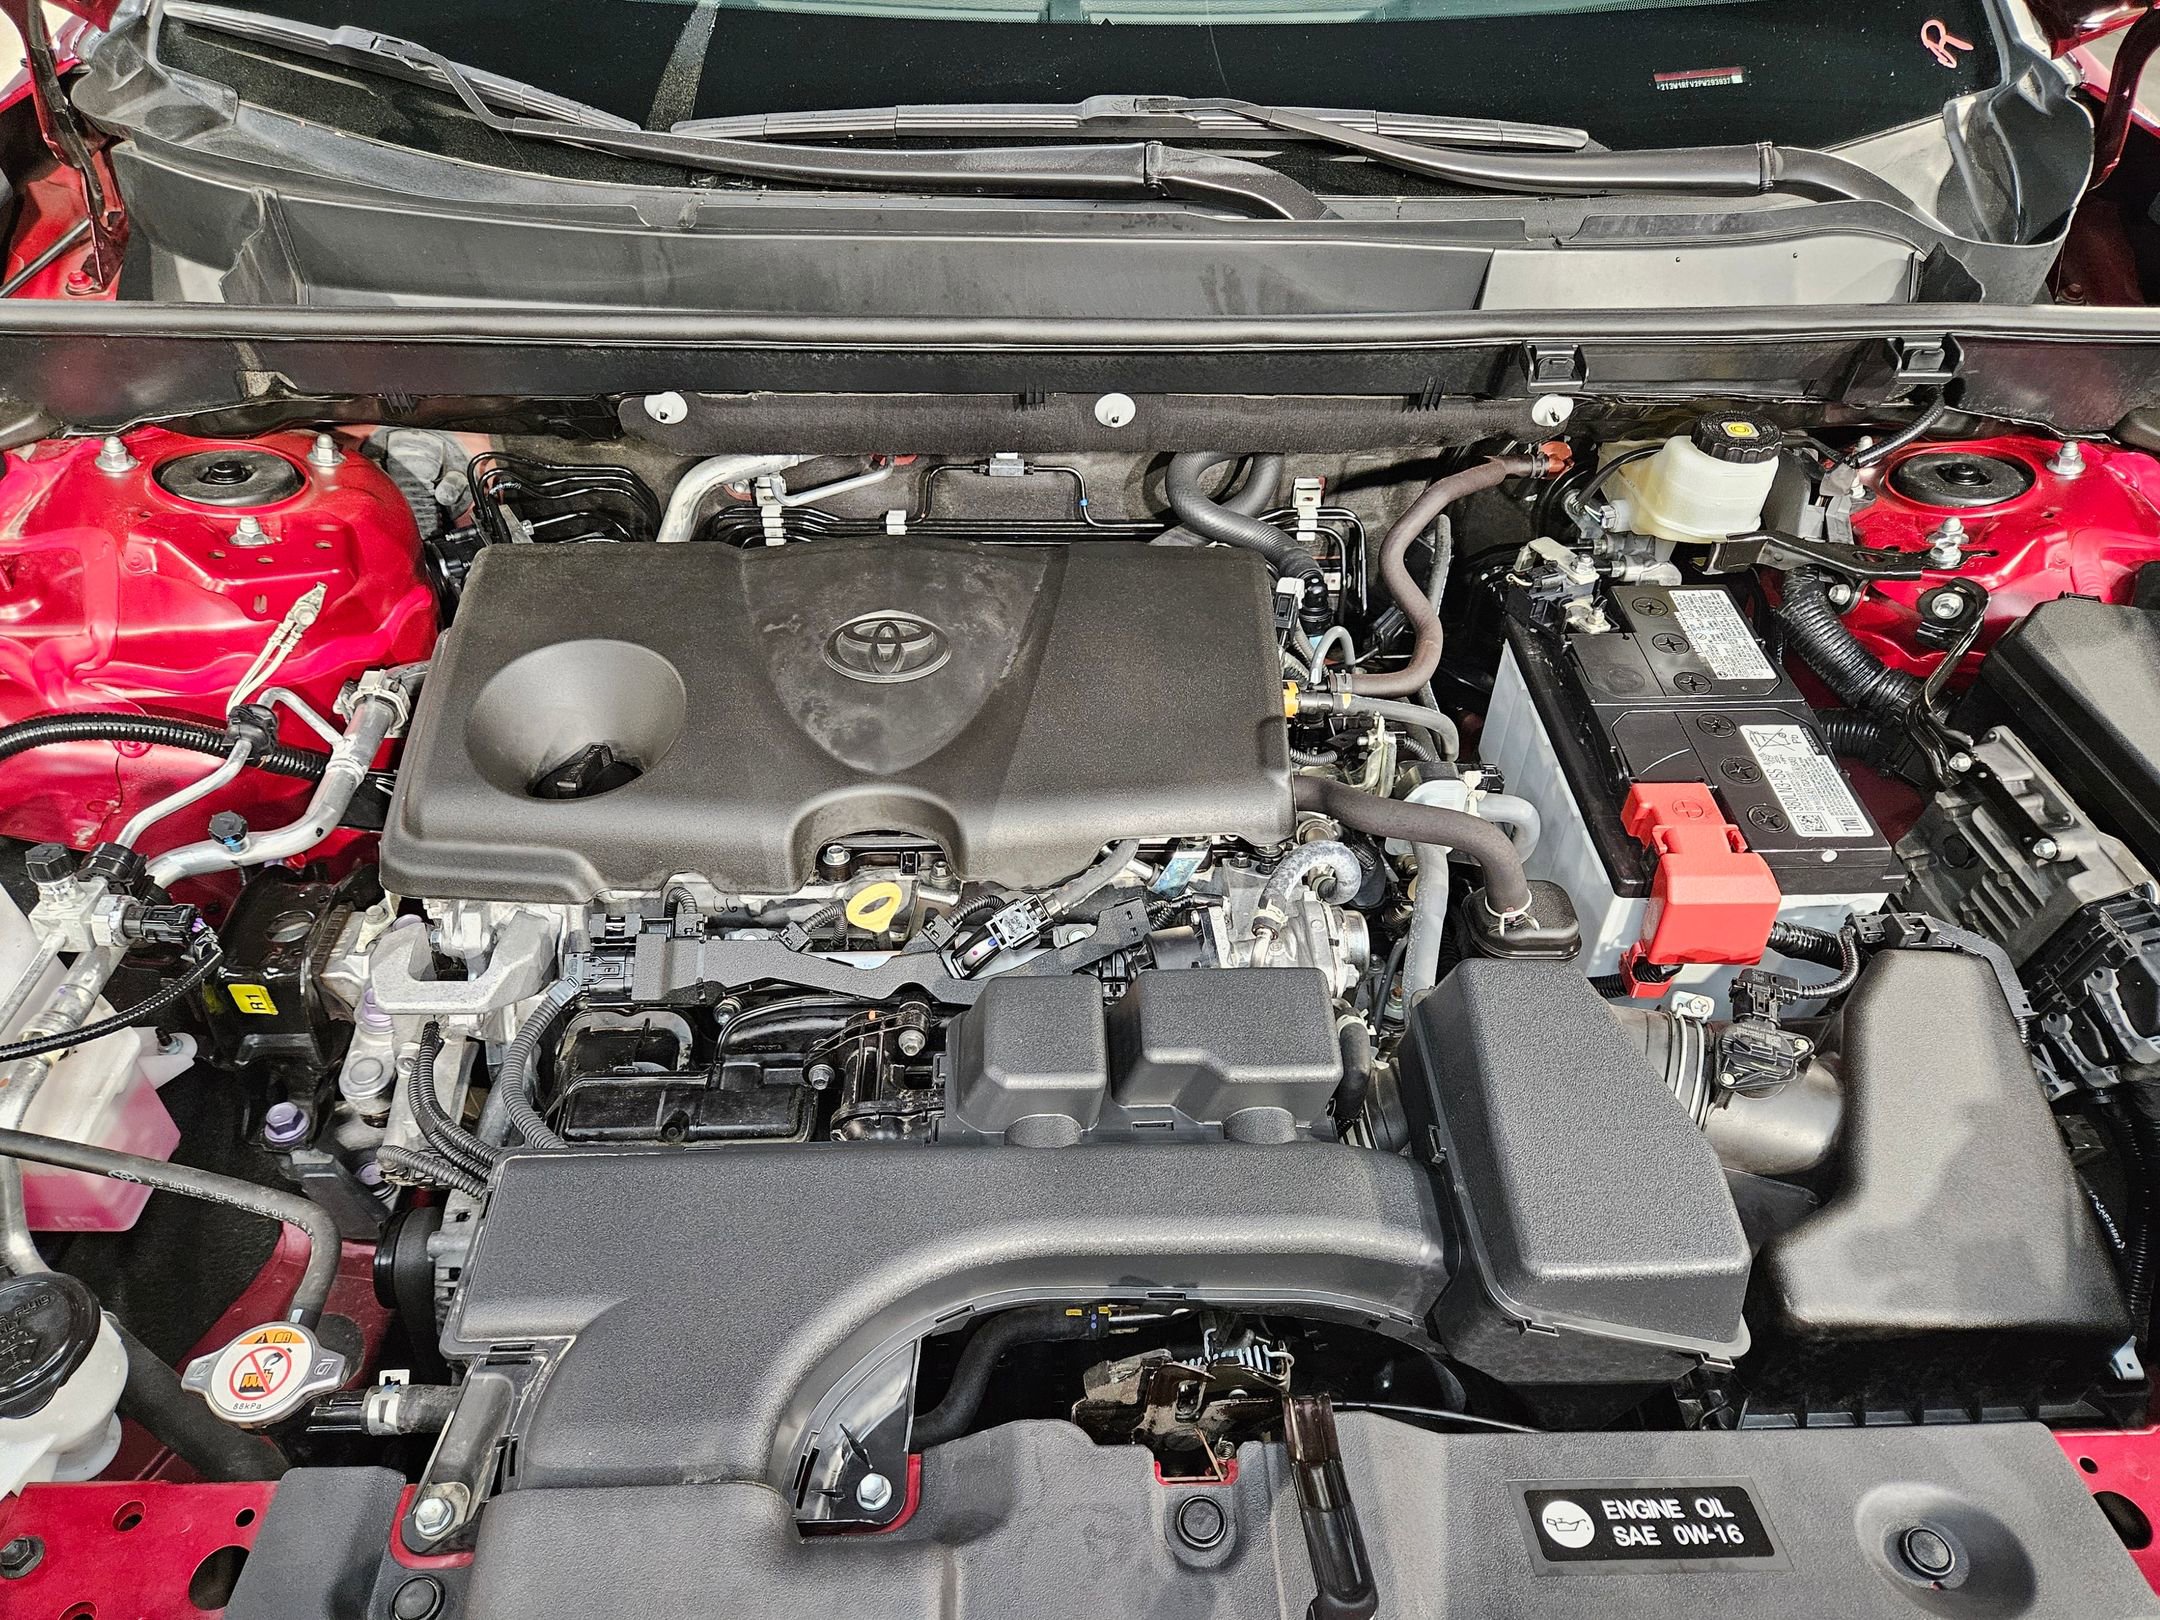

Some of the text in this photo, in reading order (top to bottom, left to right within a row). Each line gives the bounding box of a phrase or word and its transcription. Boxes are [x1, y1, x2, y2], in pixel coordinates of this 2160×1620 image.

[1920, 19, 1974, 68] R
[245, 994, 267, 1010] R1
[169, 1181, 203, 1196] WATER
[232, 1401, 262, 1411] 88kPa
[1601, 1496, 1735, 1520] ENGINE OIL
[1612, 1523, 1745, 1547] SAE 0W-16
